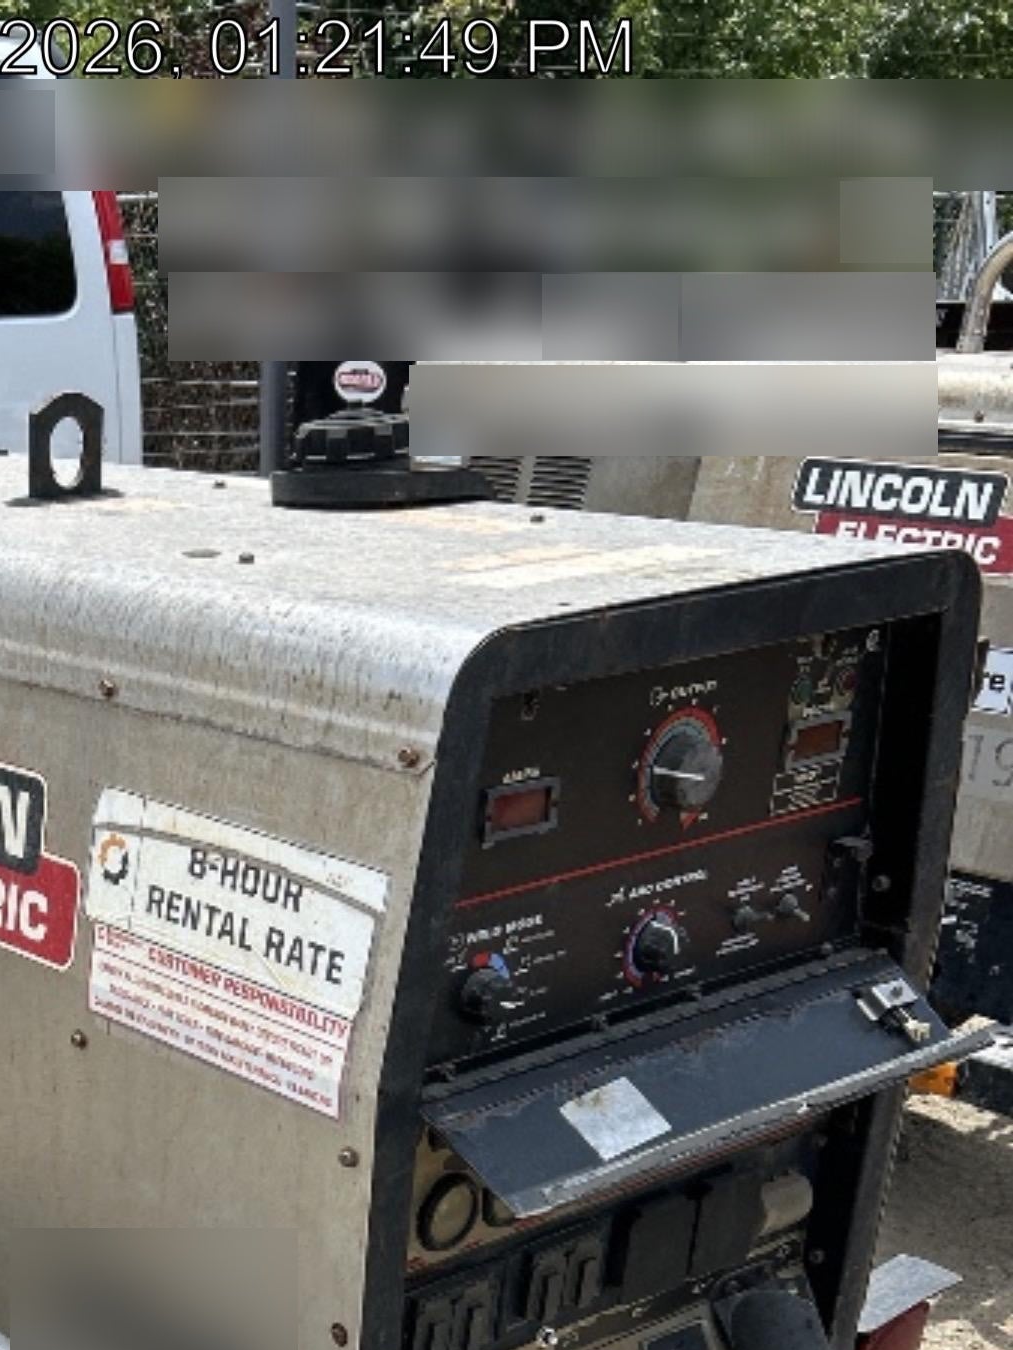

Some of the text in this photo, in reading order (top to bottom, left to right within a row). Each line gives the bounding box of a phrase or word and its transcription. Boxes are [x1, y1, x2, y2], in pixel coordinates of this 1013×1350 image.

[803, 467, 994, 520] LINCOLN
[189, 848, 303, 912] 8-HOUR
[146, 885, 346, 985] RENTAL RATE
